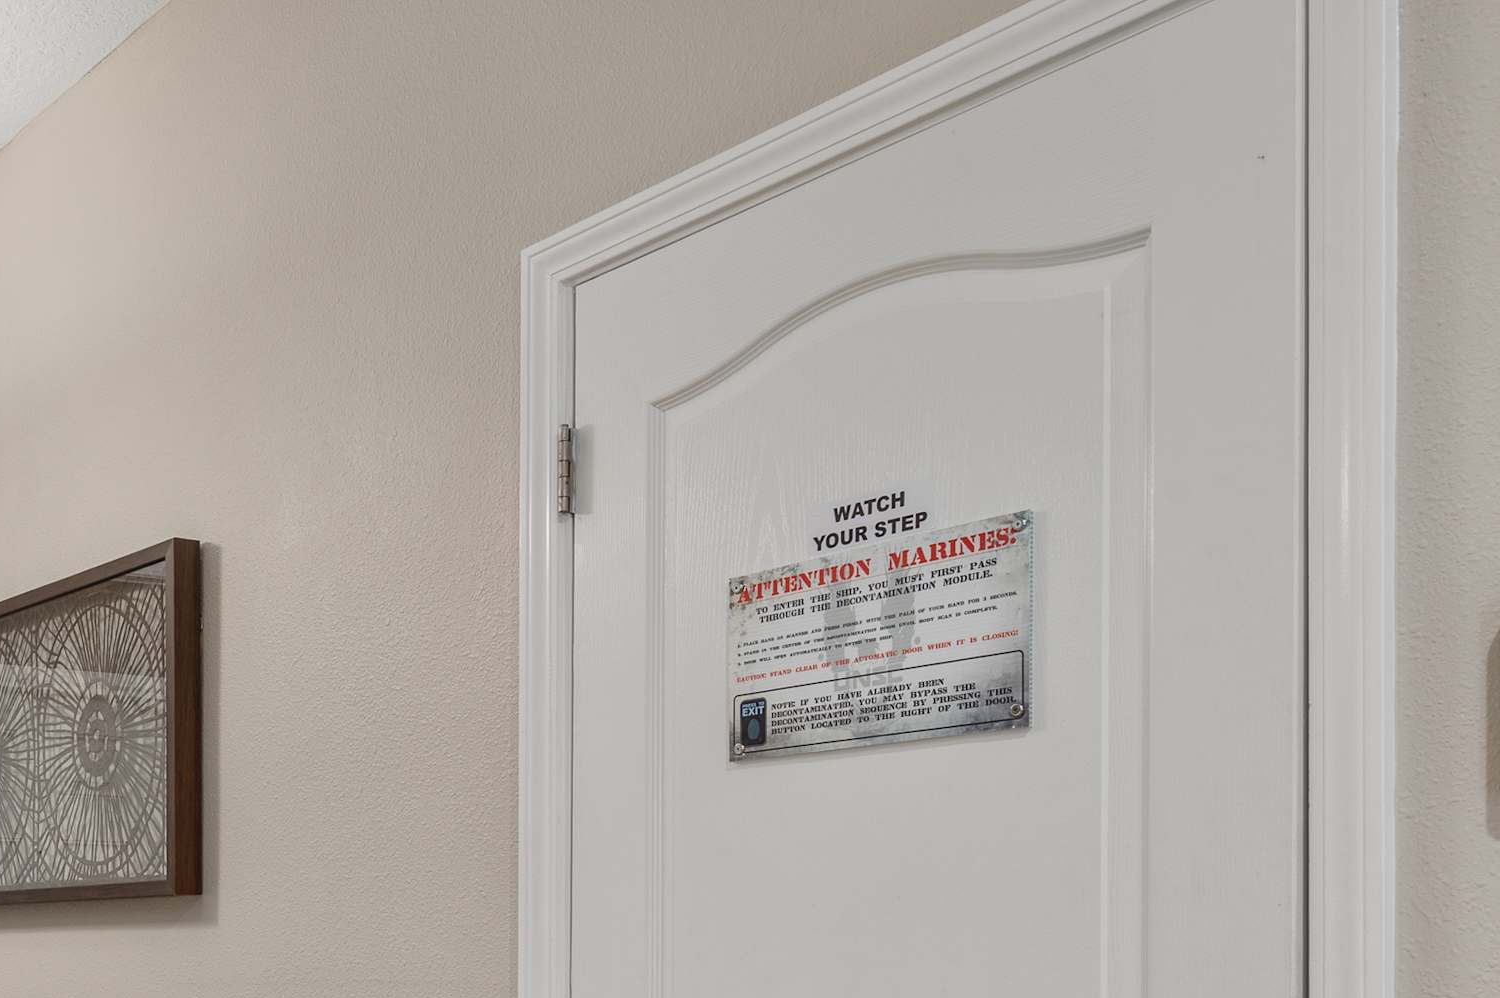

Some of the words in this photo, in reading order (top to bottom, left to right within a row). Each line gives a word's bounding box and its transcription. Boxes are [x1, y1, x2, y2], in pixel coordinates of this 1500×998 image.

[833, 491, 905, 522] WATCH
[813, 526, 868, 551] YOUR
[874, 511, 928, 538] STEP
[738, 558, 871, 604] ATTENTION
[756, 606, 768, 615] TO
[774, 598, 804, 611] ENTER
[810, 593, 830, 603] THE
[869, 580, 888, 591] YOU
[895, 573, 924, 586] MUST
[931, 565, 962, 578] FIRST
[970, 558, 997, 570] PASS
[759, 608, 804, 623] THROUGH
[810, 602, 831, 613] THE
[836, 581, 936, 608] DECONTAMINATION
[943, 570, 993, 586] MODULE.
[770, 669, 791, 677] STAND
[796, 664, 817, 673] CLEAR
[854, 651, 897, 663] AUTOMATIC
[901, 646, 922, 655] DOOR
[927, 641, 952, 651] WHEN
[772, 709, 854, 726] DECONTAMINATION
[860, 702, 907, 714] SEQUENCE
[913, 699, 926, 707] BY
[933, 691, 980, 704] PRESSING
[987, 687, 1012, 696] THIS
[815, 695, 831, 703] YOU
[838, 691, 862, 700] HAVE
[868, 683, 912, 695] ALREADY
[919, 679, 944, 688] BEEN
[859, 697, 877, 706] YOU
[883, 694, 903, 702] MAY
[911, 687, 947, 698] BYPASS
[953, 683, 976, 692] THE
[742, 705, 765, 717] EXIT
[772, 724, 806, 734] BUTTON
[811, 718, 851, 729] LOCATED
[876, 712, 895, 721] THE
[901, 707, 932, 717] RIGHT
[957, 701, 979, 710] THE
[985, 696, 1017, 706] DOOR.
